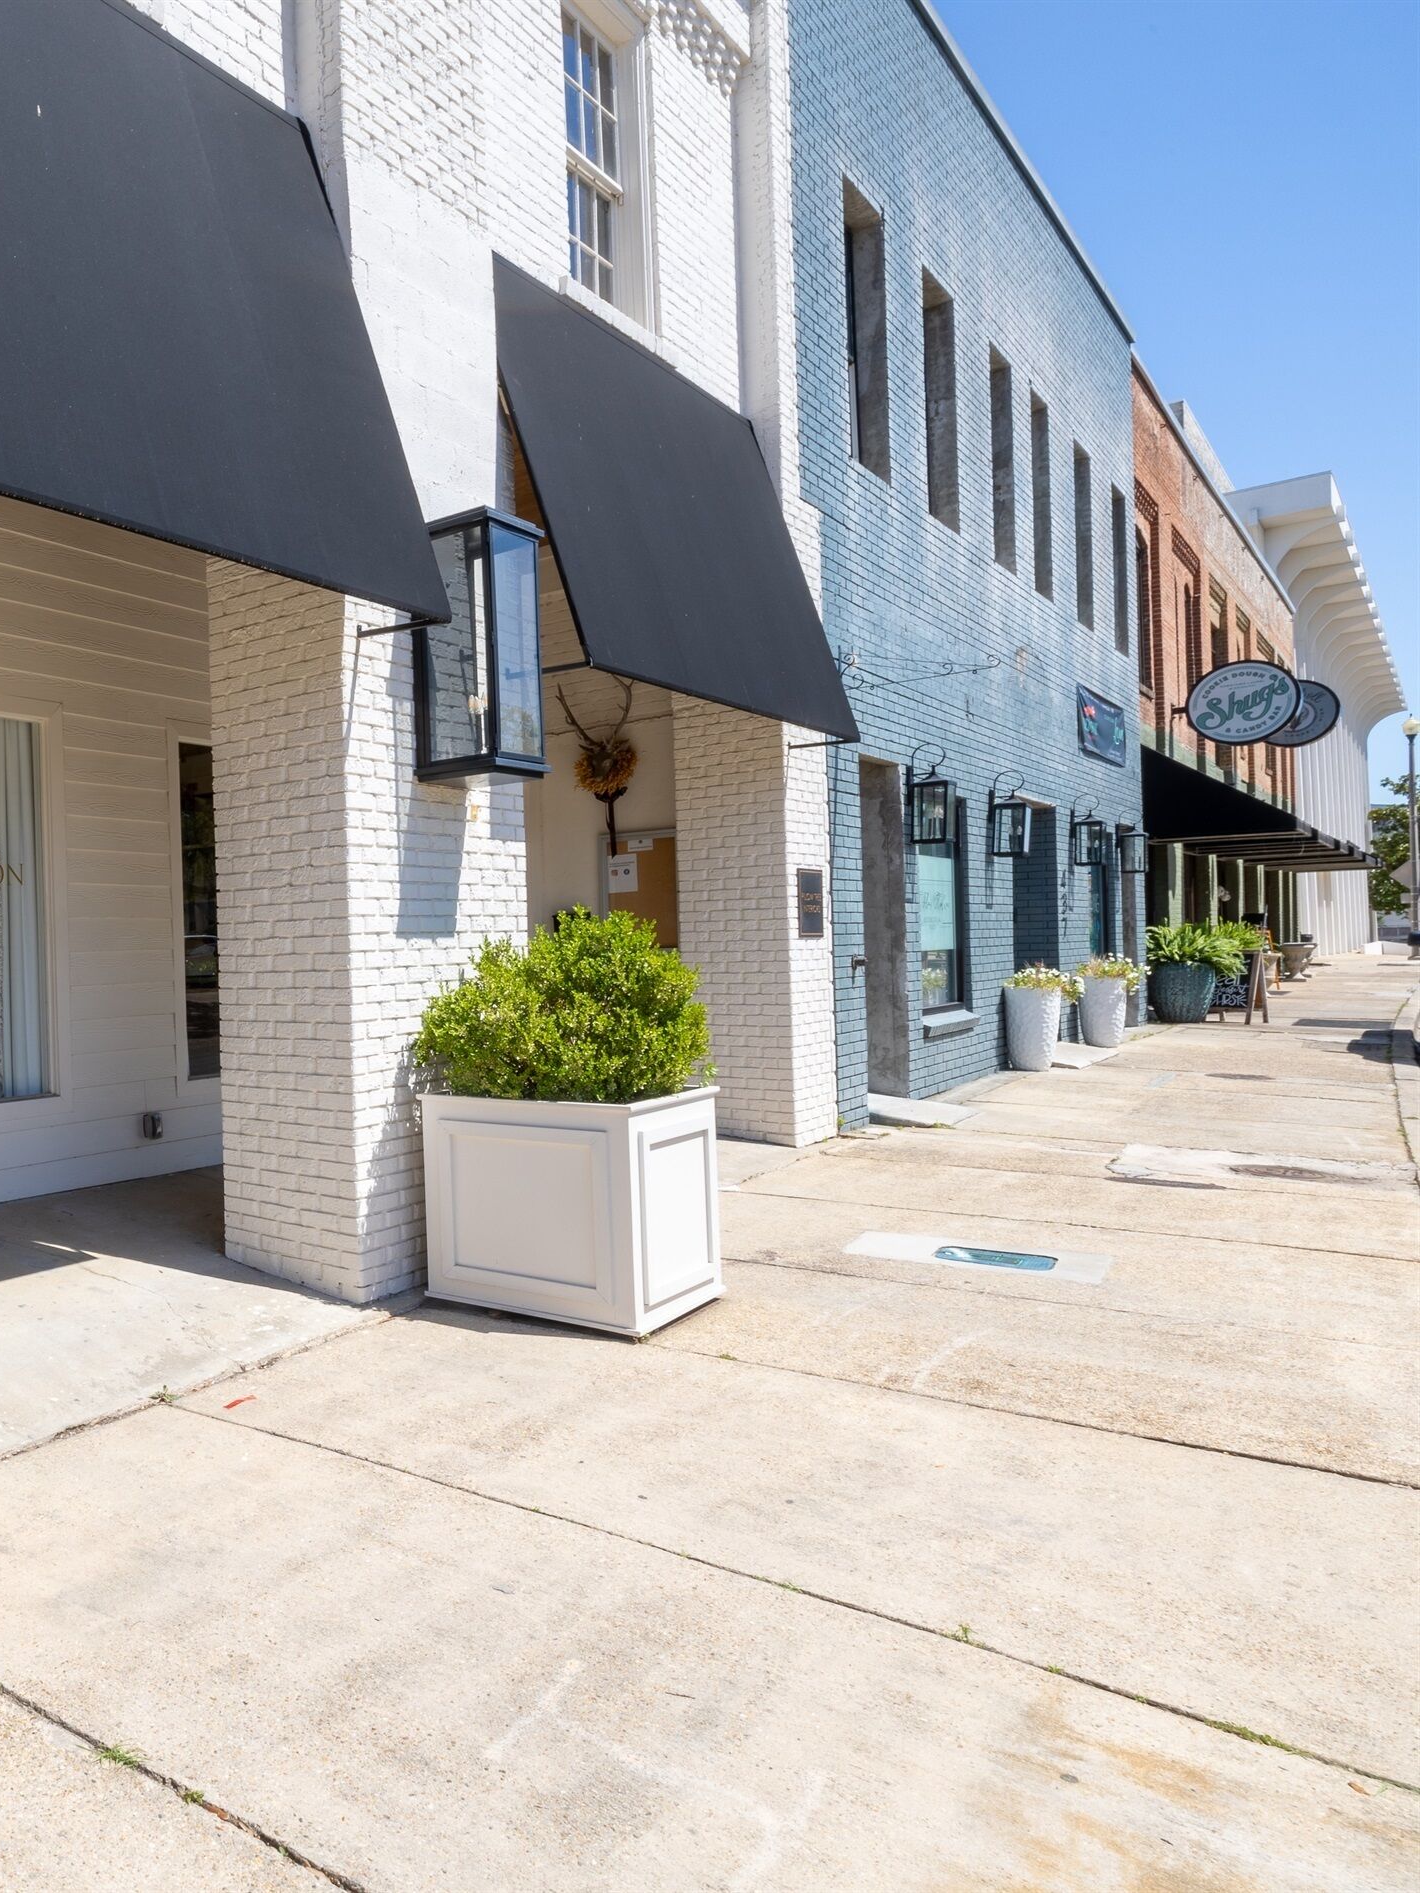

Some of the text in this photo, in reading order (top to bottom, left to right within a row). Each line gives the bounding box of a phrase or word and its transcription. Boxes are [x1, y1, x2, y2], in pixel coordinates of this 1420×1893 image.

[1202, 675, 1229, 699] COOKIE
[1231, 671, 1266, 680] DOUGH
[1235, 720, 1267, 734] CANDY
[1268, 705, 1283, 721] BAR
